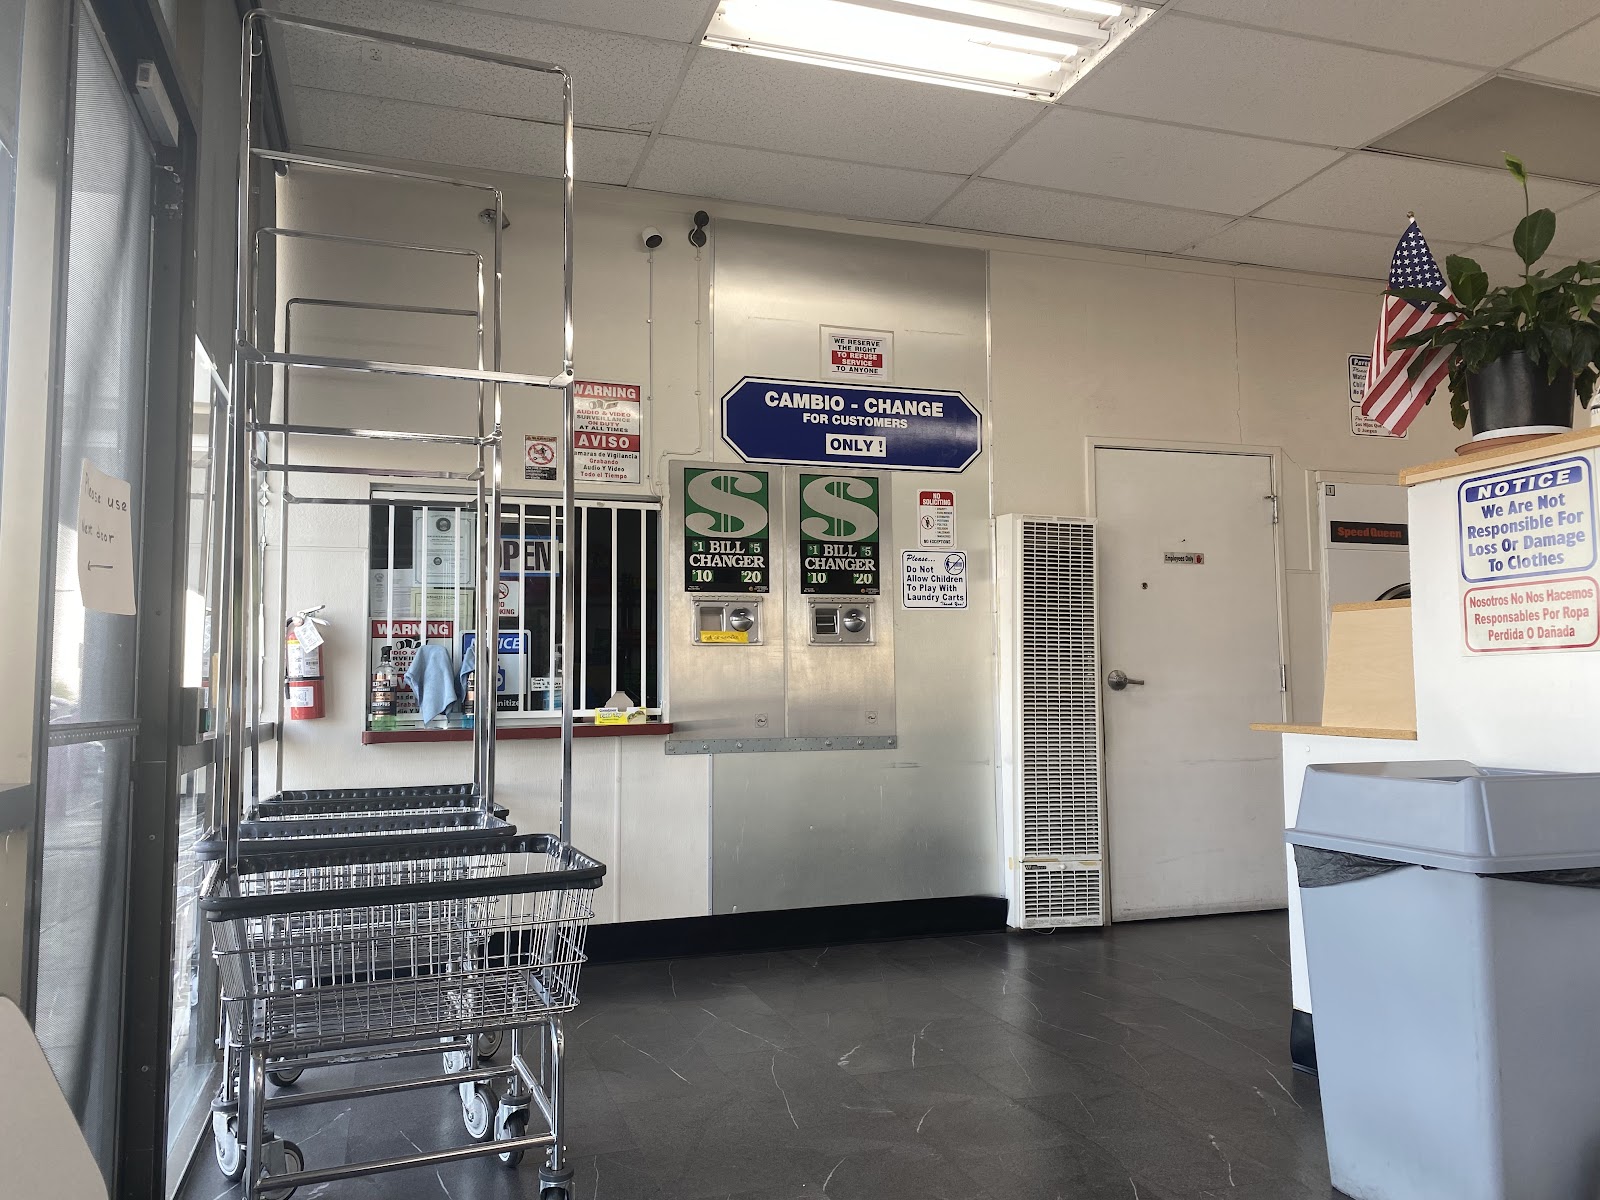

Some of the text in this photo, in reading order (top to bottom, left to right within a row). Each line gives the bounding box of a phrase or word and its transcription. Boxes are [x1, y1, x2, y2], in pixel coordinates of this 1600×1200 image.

[848, 339, 880, 347] RESERVE
[850, 352, 878, 360] REFUSE
[574, 384, 636, 399] WARNING
[765, 390, 844, 412] CAMBIO
[865, 398, 943, 417] CHANGE
[577, 414, 631, 422] SURVEILLANCE
[803, 412, 908, 428] FOR CUSTOMERS
[578, 434, 629, 448] AVISO
[830, 438, 874, 452] ONLY
[607, 452, 638, 460] Vigilancia
[1478, 470, 1571, 499] NOTICE
[107, 497, 127, 511] use
[922, 498, 951, 506] SOLICITING
[1481, 493, 1566, 519] We Are Not
[1337, 526, 1402, 538] Speed Queen
[1467, 511, 1584, 539] Responsible For
[709, 541, 746, 554] BILL
[823, 544, 858, 557] BILL
[1468, 530, 1586, 557] Loss Or Damage
[487, 540, 551, 571] PEN
[689, 554, 766, 568] CHANGER
[1488, 552, 1565, 572] To Clothes
[805, 557, 877, 571] CHANGER
[931, 575, 963, 583] Children
[920, 584, 937, 594] Play
[907, 593, 964, 603] Laundry Carts
[1469, 588, 1594, 608] Nosotros No Nos Hacemos
[1474, 606, 1590, 626] Responsables Por Ropa
[377, 624, 449, 635] WARNNG
[1488, 625, 1575, 641] Perdida O Dañada
